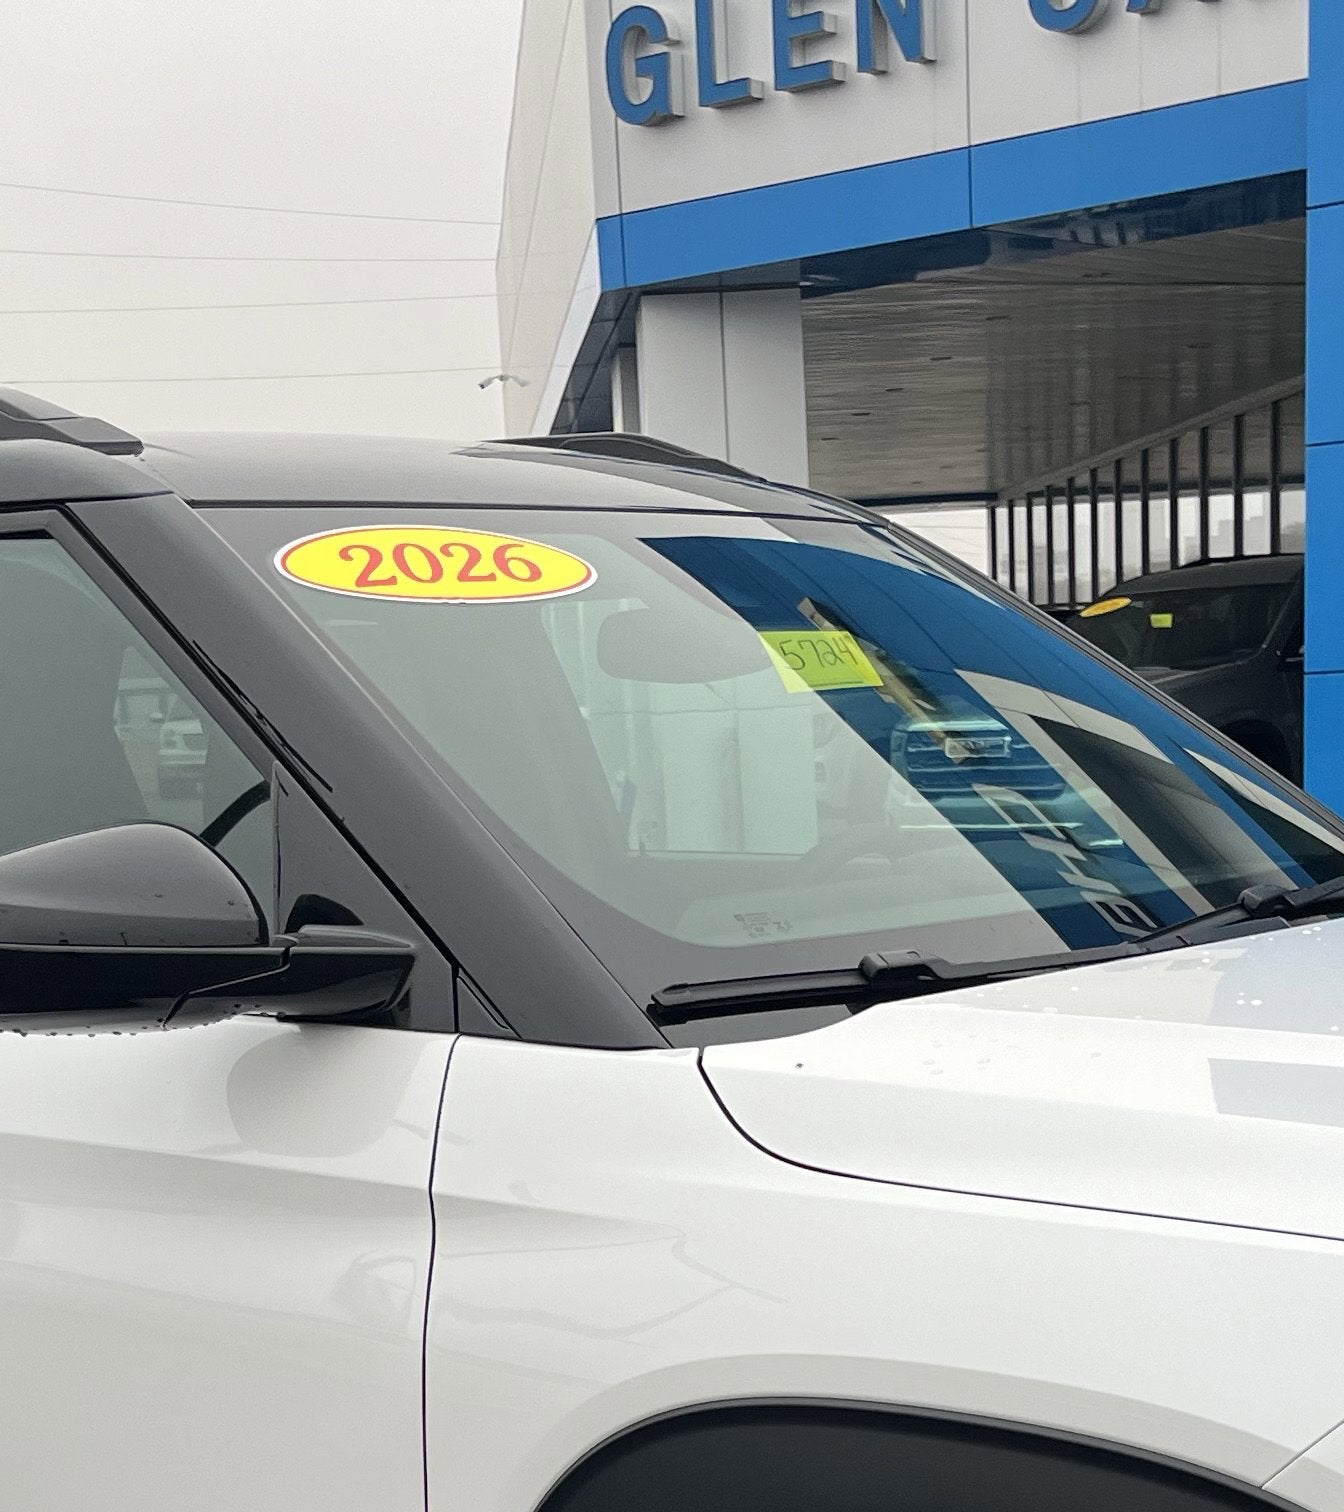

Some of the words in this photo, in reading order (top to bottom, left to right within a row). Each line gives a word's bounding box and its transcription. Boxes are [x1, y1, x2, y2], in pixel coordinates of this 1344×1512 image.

[606, 0, 934, 126] GLEN
[338, 541, 543, 588] 2026
[777, 638, 859, 671] 5724
